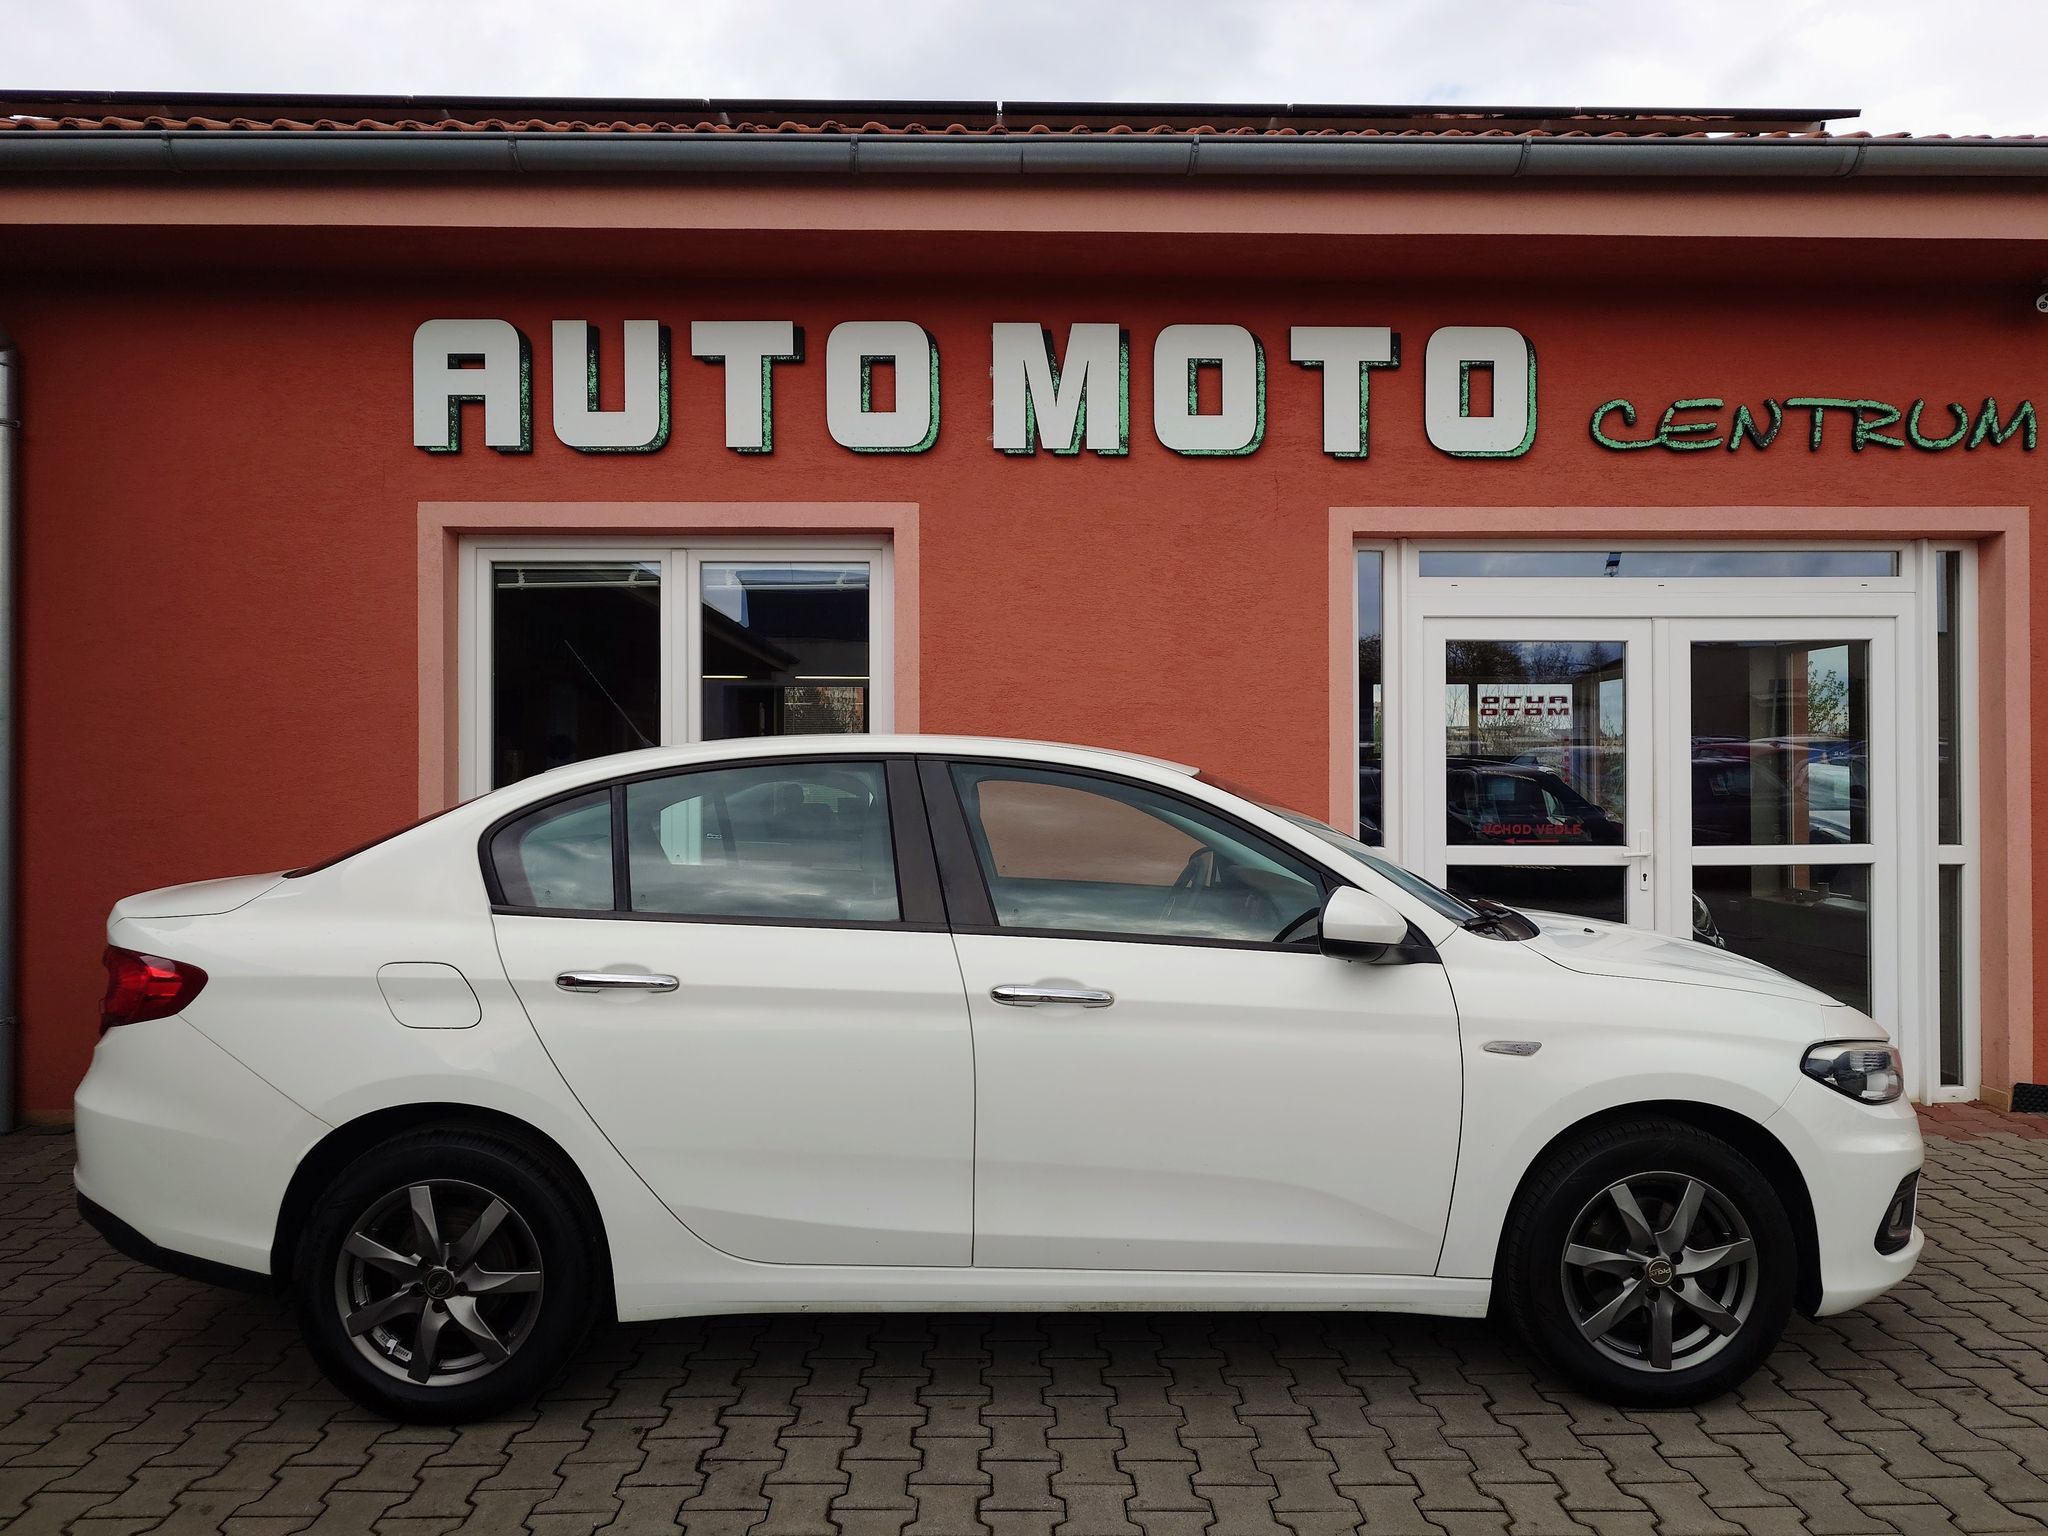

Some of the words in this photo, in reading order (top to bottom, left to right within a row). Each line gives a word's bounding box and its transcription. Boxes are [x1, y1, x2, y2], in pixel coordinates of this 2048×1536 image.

[412, 318, 938, 453] AUTO
[992, 322, 1537, 457] MOTO
[1589, 397, 2037, 452] CENTRUM
[1535, 823, 1582, 835] VEDLE
